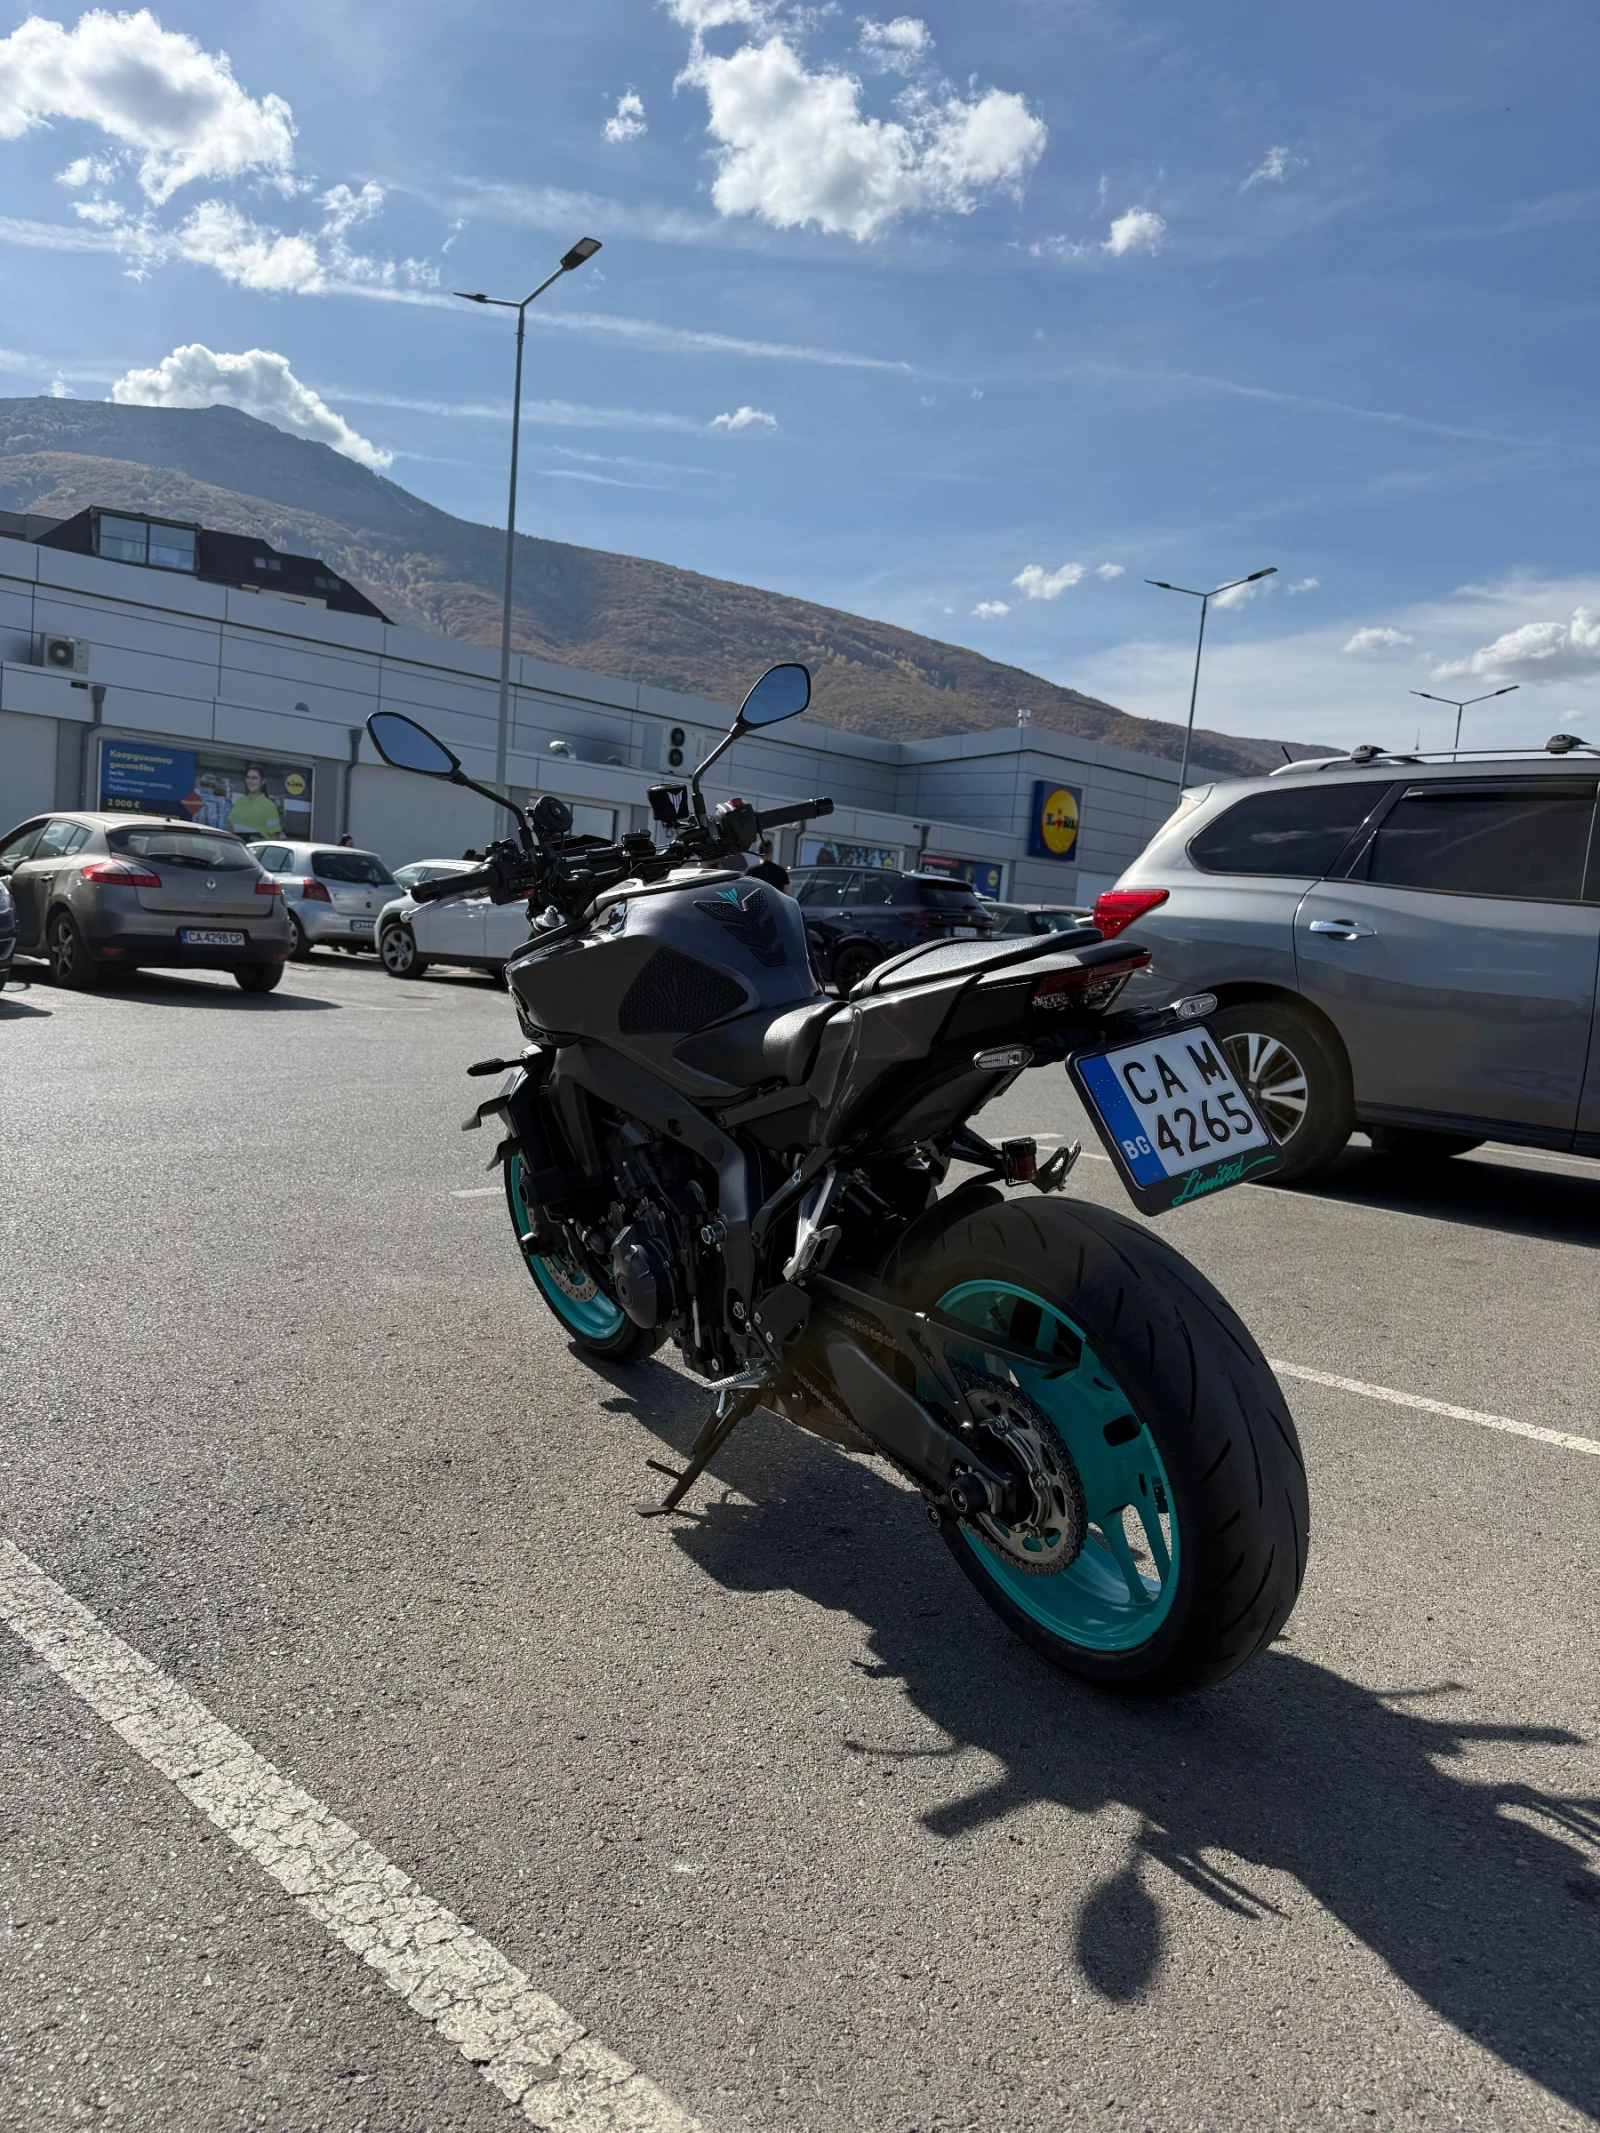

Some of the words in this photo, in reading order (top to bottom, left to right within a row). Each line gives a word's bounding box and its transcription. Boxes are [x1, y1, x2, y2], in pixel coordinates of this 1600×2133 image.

[109, 750, 173, 765] Координатор
[109, 762, 155, 772] доставки
[107, 798, 113, 806] 2
[115, 799, 133, 808] 000
[189, 932, 203, 942] CA
[204, 933, 229, 943] 4298
[230, 934, 242, 943] CP
[1122, 1054, 1188, 1105] CA
[1185, 1040, 1227, 1086] M
[1156, 1091, 1253, 1157] 4265
[1121, 1135, 1150, 1160] BG
[1171, 1155, 1276, 1206] Limited
